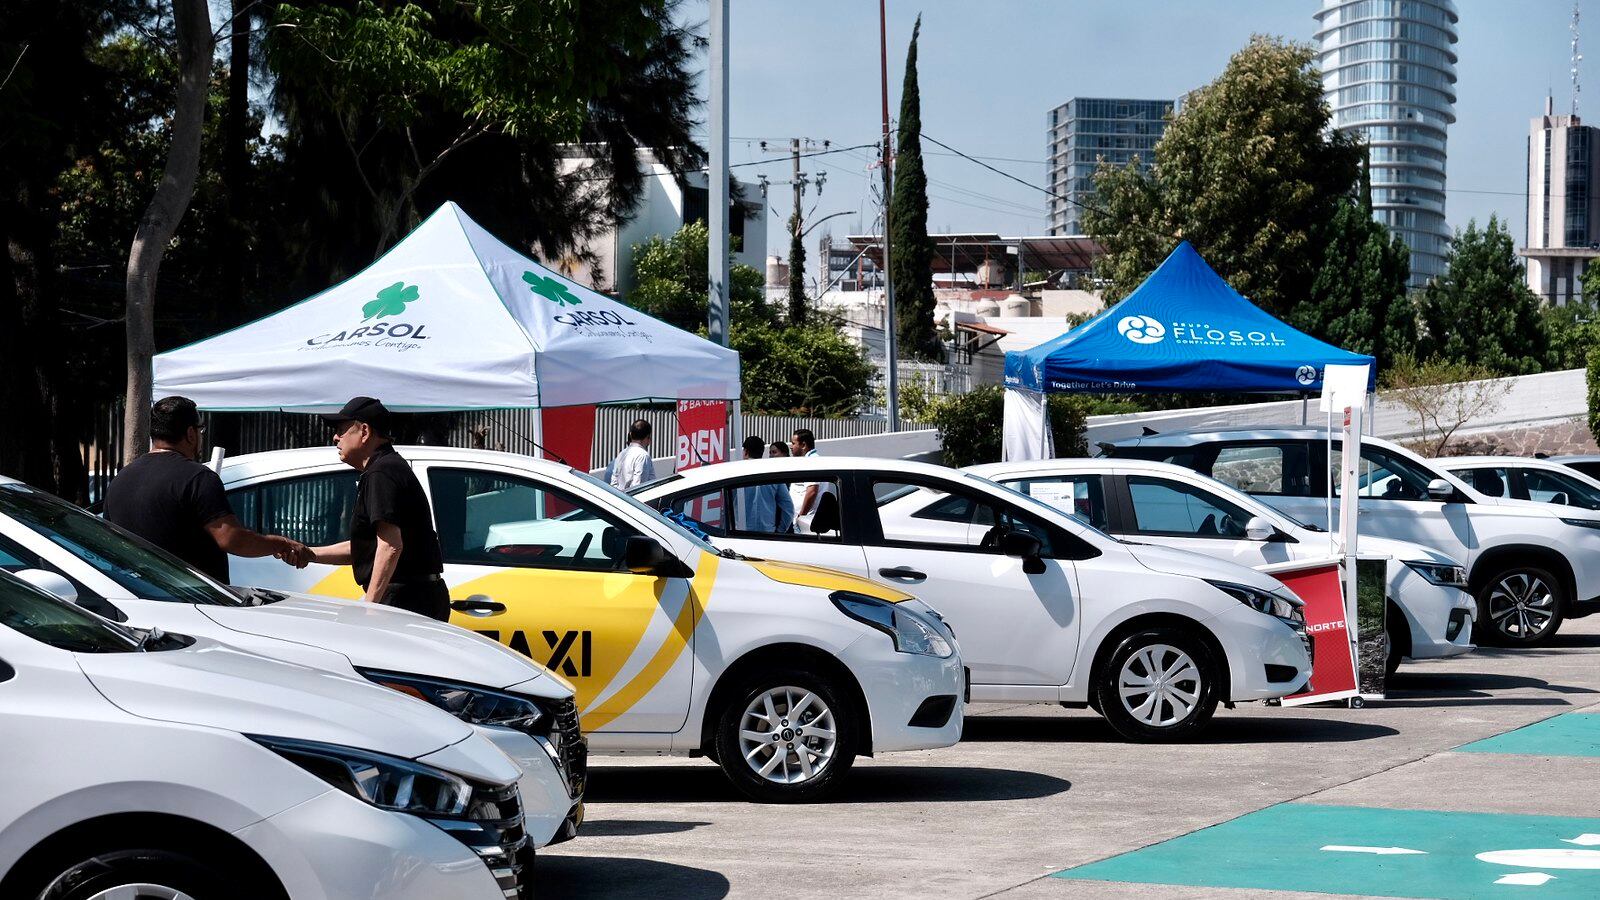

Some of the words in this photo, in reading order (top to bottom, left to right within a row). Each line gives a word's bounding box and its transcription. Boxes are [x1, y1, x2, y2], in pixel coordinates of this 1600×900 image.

[553, 310, 634, 326] CARSOL
[307, 322, 427, 345] CARSOL
[1173, 328, 1285, 342] FLOSOL
[1051, 381, 1089, 390] Together
[1091, 381, 1112, 389] Let's
[1113, 381, 1136, 389] Drive
[676, 427, 724, 469] BIEN
[1305, 620, 1344, 632] NORTE
[474, 630, 592, 677] AXI
